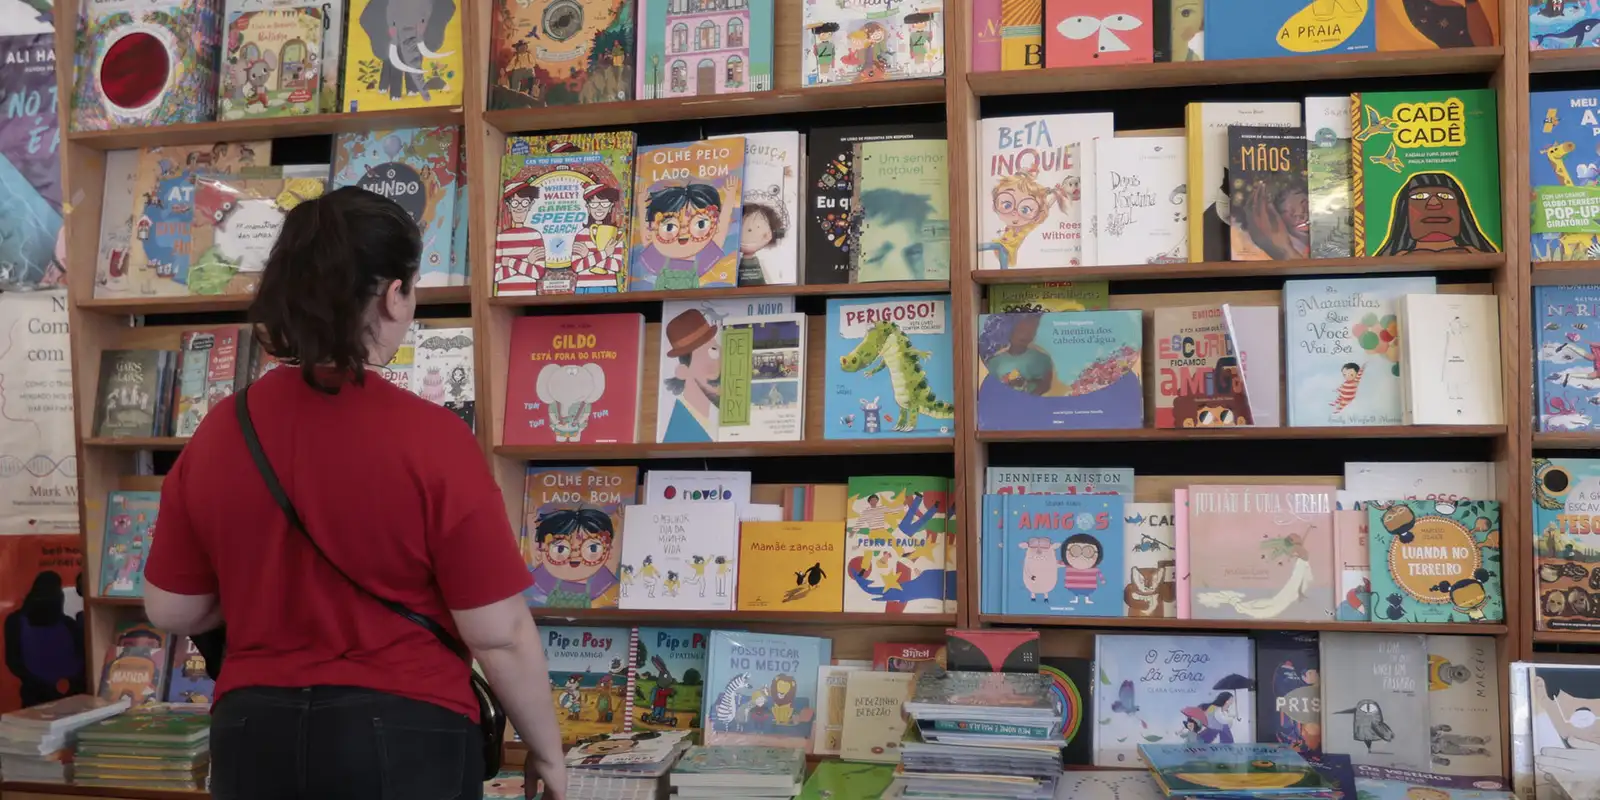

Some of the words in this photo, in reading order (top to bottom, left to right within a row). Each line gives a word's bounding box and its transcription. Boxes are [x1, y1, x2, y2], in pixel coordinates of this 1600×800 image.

[1281, 26, 1290, 40] A
[1297, 24, 1342, 38] PRAIA
[6, 51, 30, 64] ALI
[8, 84, 42, 119] NO
[1570, 98, 1597, 108] MEU
[1397, 102, 1460, 123] CADÊ
[997, 119, 1053, 150] BETA
[1397, 123, 1461, 144] CADÊ
[653, 150, 691, 165] OLHE
[696, 148, 730, 161] PELO
[879, 154, 900, 164] Um
[903, 152, 944, 163] senhor
[1241, 143, 1290, 172] MÃOS
[652, 168, 690, 182] LADO
[699, 164, 729, 177] BOM
[362, 180, 419, 198] MUNDO
[544, 184, 580, 193] WHERE'S
[544, 191, 579, 201] WALLY?
[817, 196, 835, 209] Eu
[538, 204, 581, 213] GAMES
[1545, 205, 1600, 221] POP-UP
[530, 211, 587, 225] SPEED
[1546, 218, 1590, 229] GIRATÓRIO
[542, 223, 577, 235] SEARCH
[1296, 292, 1381, 317] Maravilhas
[846, 302, 936, 326] PERIGOSO!
[1326, 310, 1350, 323] Que
[1052, 327, 1059, 336] A
[1060, 327, 1095, 336] menina
[1096, 325, 1113, 335] dos
[1307, 322, 1350, 340] Você
[552, 333, 597, 350] GILDO
[729, 337, 744, 356] DE
[1052, 336, 1083, 345] cabelos
[1084, 334, 1117, 346] d'água
[1300, 340, 1327, 354] Vai
[27, 346, 65, 362] com
[531, 350, 552, 361] ESTÁ
[554, 351, 576, 361] FORA
[578, 351, 589, 361] DO
[592, 350, 618, 360] RITMO
[1170, 358, 1207, 367] FICAMOS
[727, 378, 742, 398] VE
[524, 402, 541, 410] TUM
[727, 399, 743, 417] RY
[593, 409, 609, 419] TUM
[529, 418, 545, 428] TUM
[543, 474, 582, 487] OLHE
[588, 475, 622, 486] PELO
[998, 473, 1059, 483] JENNIFER
[1064, 472, 1121, 484] ANISTON
[29, 485, 61, 497] Mark
[542, 491, 581, 504] LADO
[591, 490, 621, 504] BOM
[664, 485, 676, 500] O
[683, 484, 733, 500] novelo
[1579, 491, 1585, 501] A
[1195, 488, 1239, 517] JULIÃO
[1244, 488, 1251, 513] É
[1255, 493, 1281, 513] UMA
[660, 524, 673, 535] DIA
[674, 524, 686, 533] DA
[659, 534, 687, 543] MINHA
[858, 537, 887, 548] PEDRO
[886, 538, 893, 547] E
[896, 537, 926, 548] PAULO
[663, 543, 681, 554] VIDA
[750, 541, 787, 552] Mamãe
[789, 541, 834, 555] zangada
[1401, 545, 1448, 560] LUANDA
[1451, 546, 1469, 560] NO
[1407, 561, 1462, 577] TERREIRO
[548, 630, 571, 650] Pip
[582, 631, 613, 650] Posy
[657, 631, 680, 650] Pip
[560, 651, 579, 659] NOVO
[579, 651, 604, 659] AMIGO
[731, 645, 766, 656] POSSO
[769, 647, 800, 659] FICAR
[1145, 649, 1158, 664] O
[1164, 649, 1211, 669] Tempo
[730, 656, 751, 670] NO
[756, 658, 800, 673] MEIO?
[1140, 667, 1164, 682] Lá
[1168, 667, 1205, 683] Fora
[854, 696, 899, 708] BEBEZINHO
[855, 706, 892, 718] BEBEZÃO
[968, 723, 994, 733] MALALA
[999, 726, 1016, 735] NOME
[1016, 727, 1031, 736] MEU
[1358, 764, 1380, 773] Os
[1384, 767, 1452, 782] vestidos
